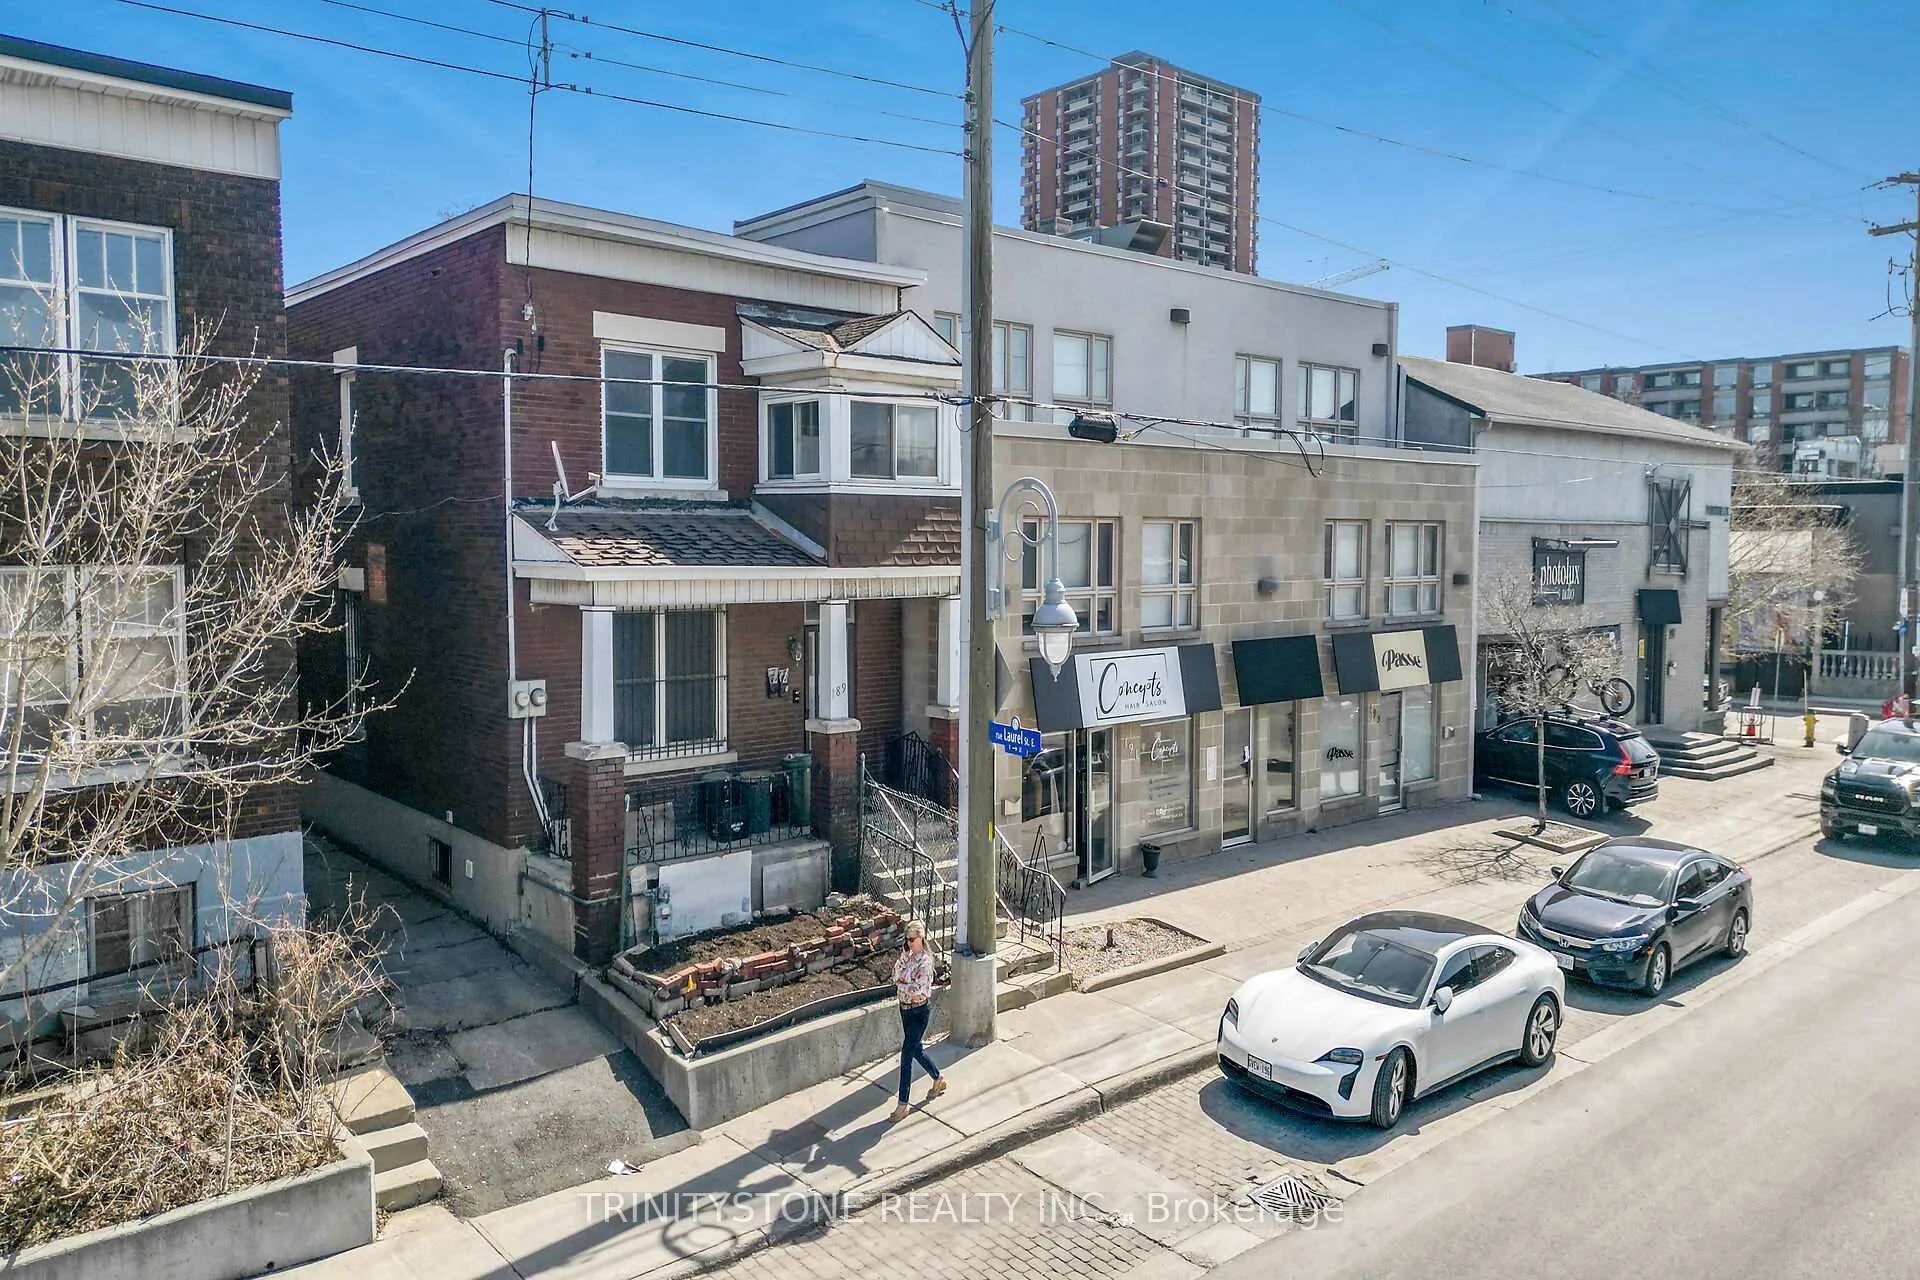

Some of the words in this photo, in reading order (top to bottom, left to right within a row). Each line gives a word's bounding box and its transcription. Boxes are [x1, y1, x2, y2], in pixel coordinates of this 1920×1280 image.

[1540, 556, 1580, 593] photolux
[1099, 662, 1161, 714] Concepts
[1124, 702, 1140, 710] HAIR
[1146, 699, 1167, 708] SALON
[1003, 728, 1023, 744] Laurel
